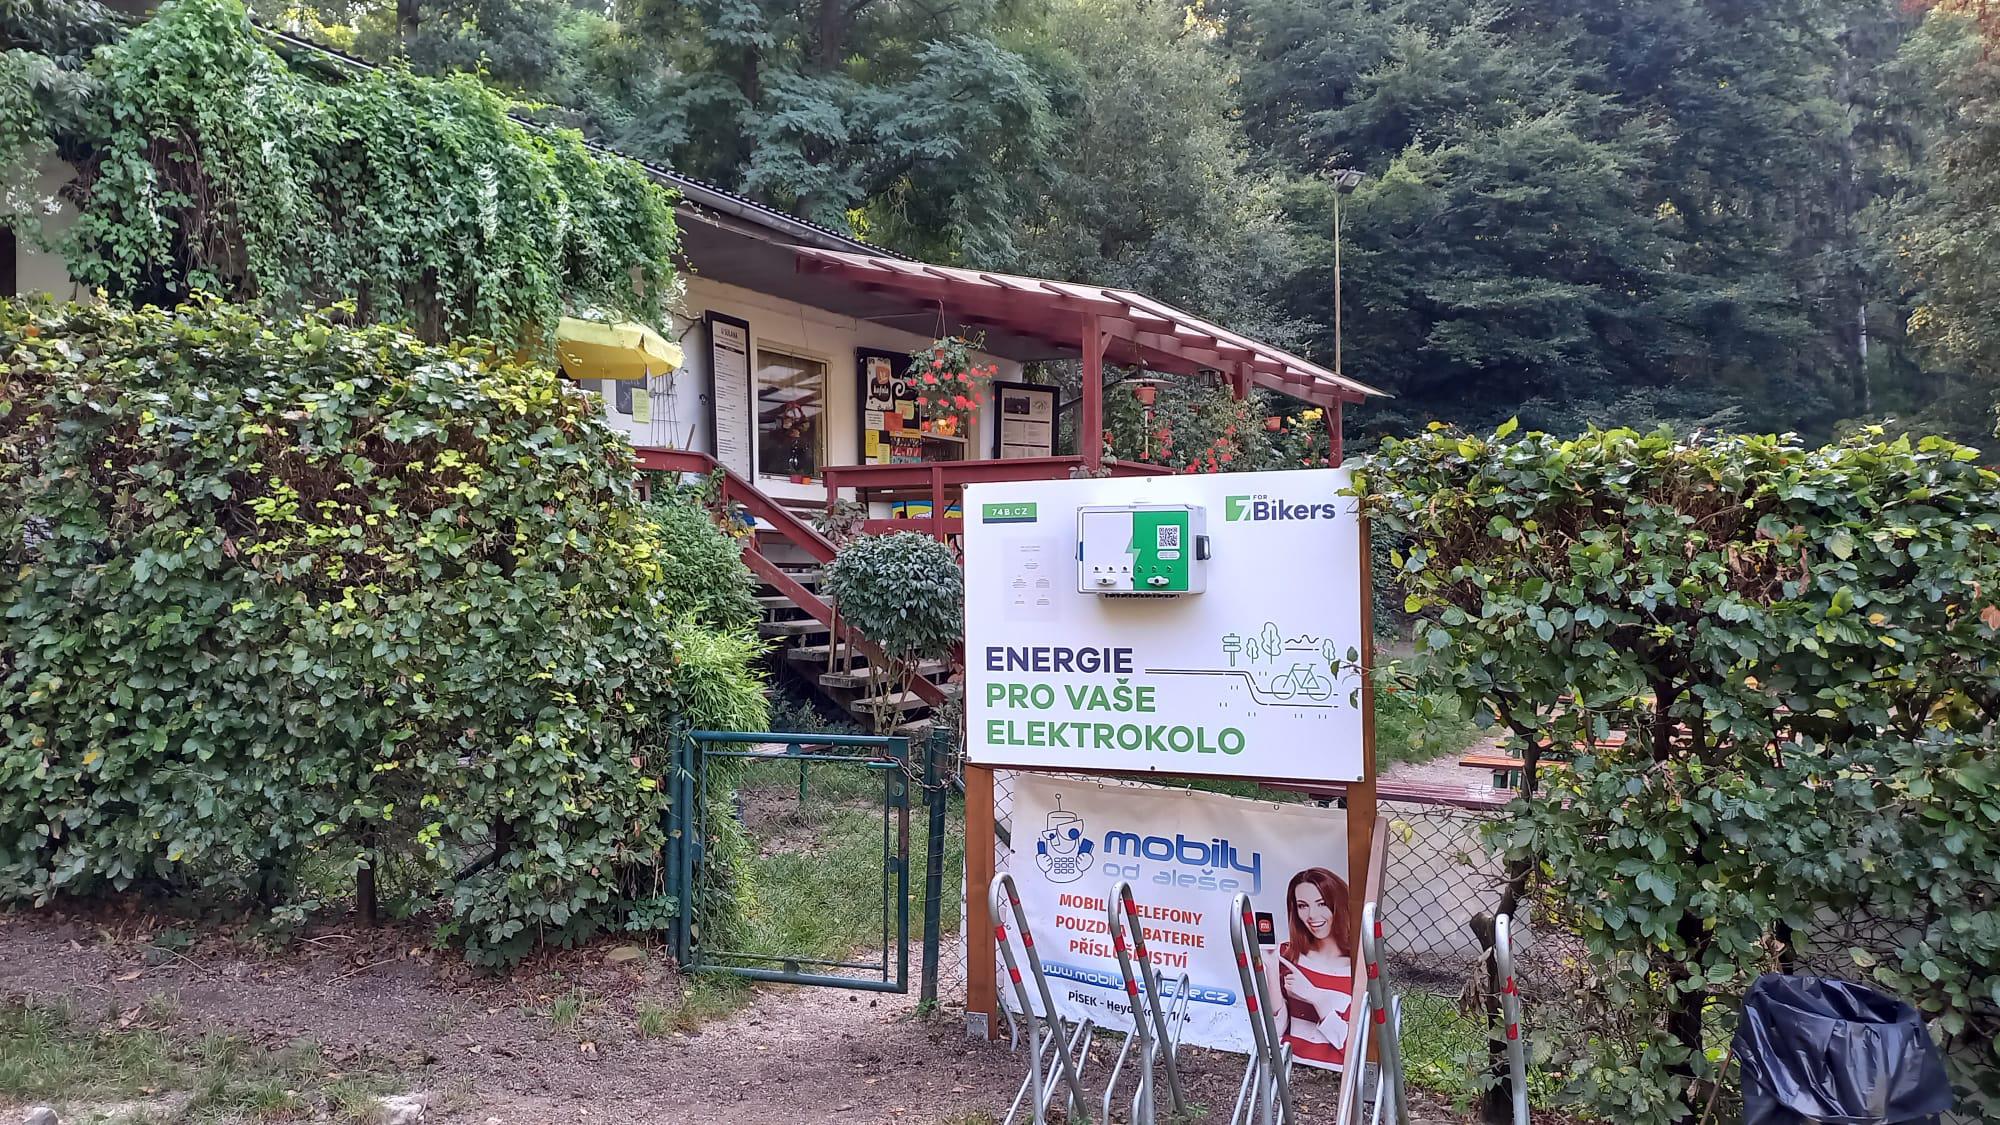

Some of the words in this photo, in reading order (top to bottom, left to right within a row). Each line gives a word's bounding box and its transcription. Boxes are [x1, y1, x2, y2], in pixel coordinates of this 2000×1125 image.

[991, 507, 1028, 516] 74B.CZ
[1253, 499, 1336, 521] Bikers
[985, 646, 1134, 674] ENERGIE
[986, 683, 1055, 710] PRO
[1064, 678, 1156, 713] VAŠE
[986, 719, 1246, 755] ELEKTROKOLO
[1102, 862, 1141, 880] od
[1152, 868, 1240, 893] aleše
[1103, 830, 1262, 897] mobily
[1058, 893, 1123, 914] MOBILÍ
[1133, 904, 1203, 926] ELEFONY
[1055, 915, 1127, 937] POUZDA
[1142, 927, 1205, 948] BATERIE
[1068, 990, 1097, 1007] PÍSEK
